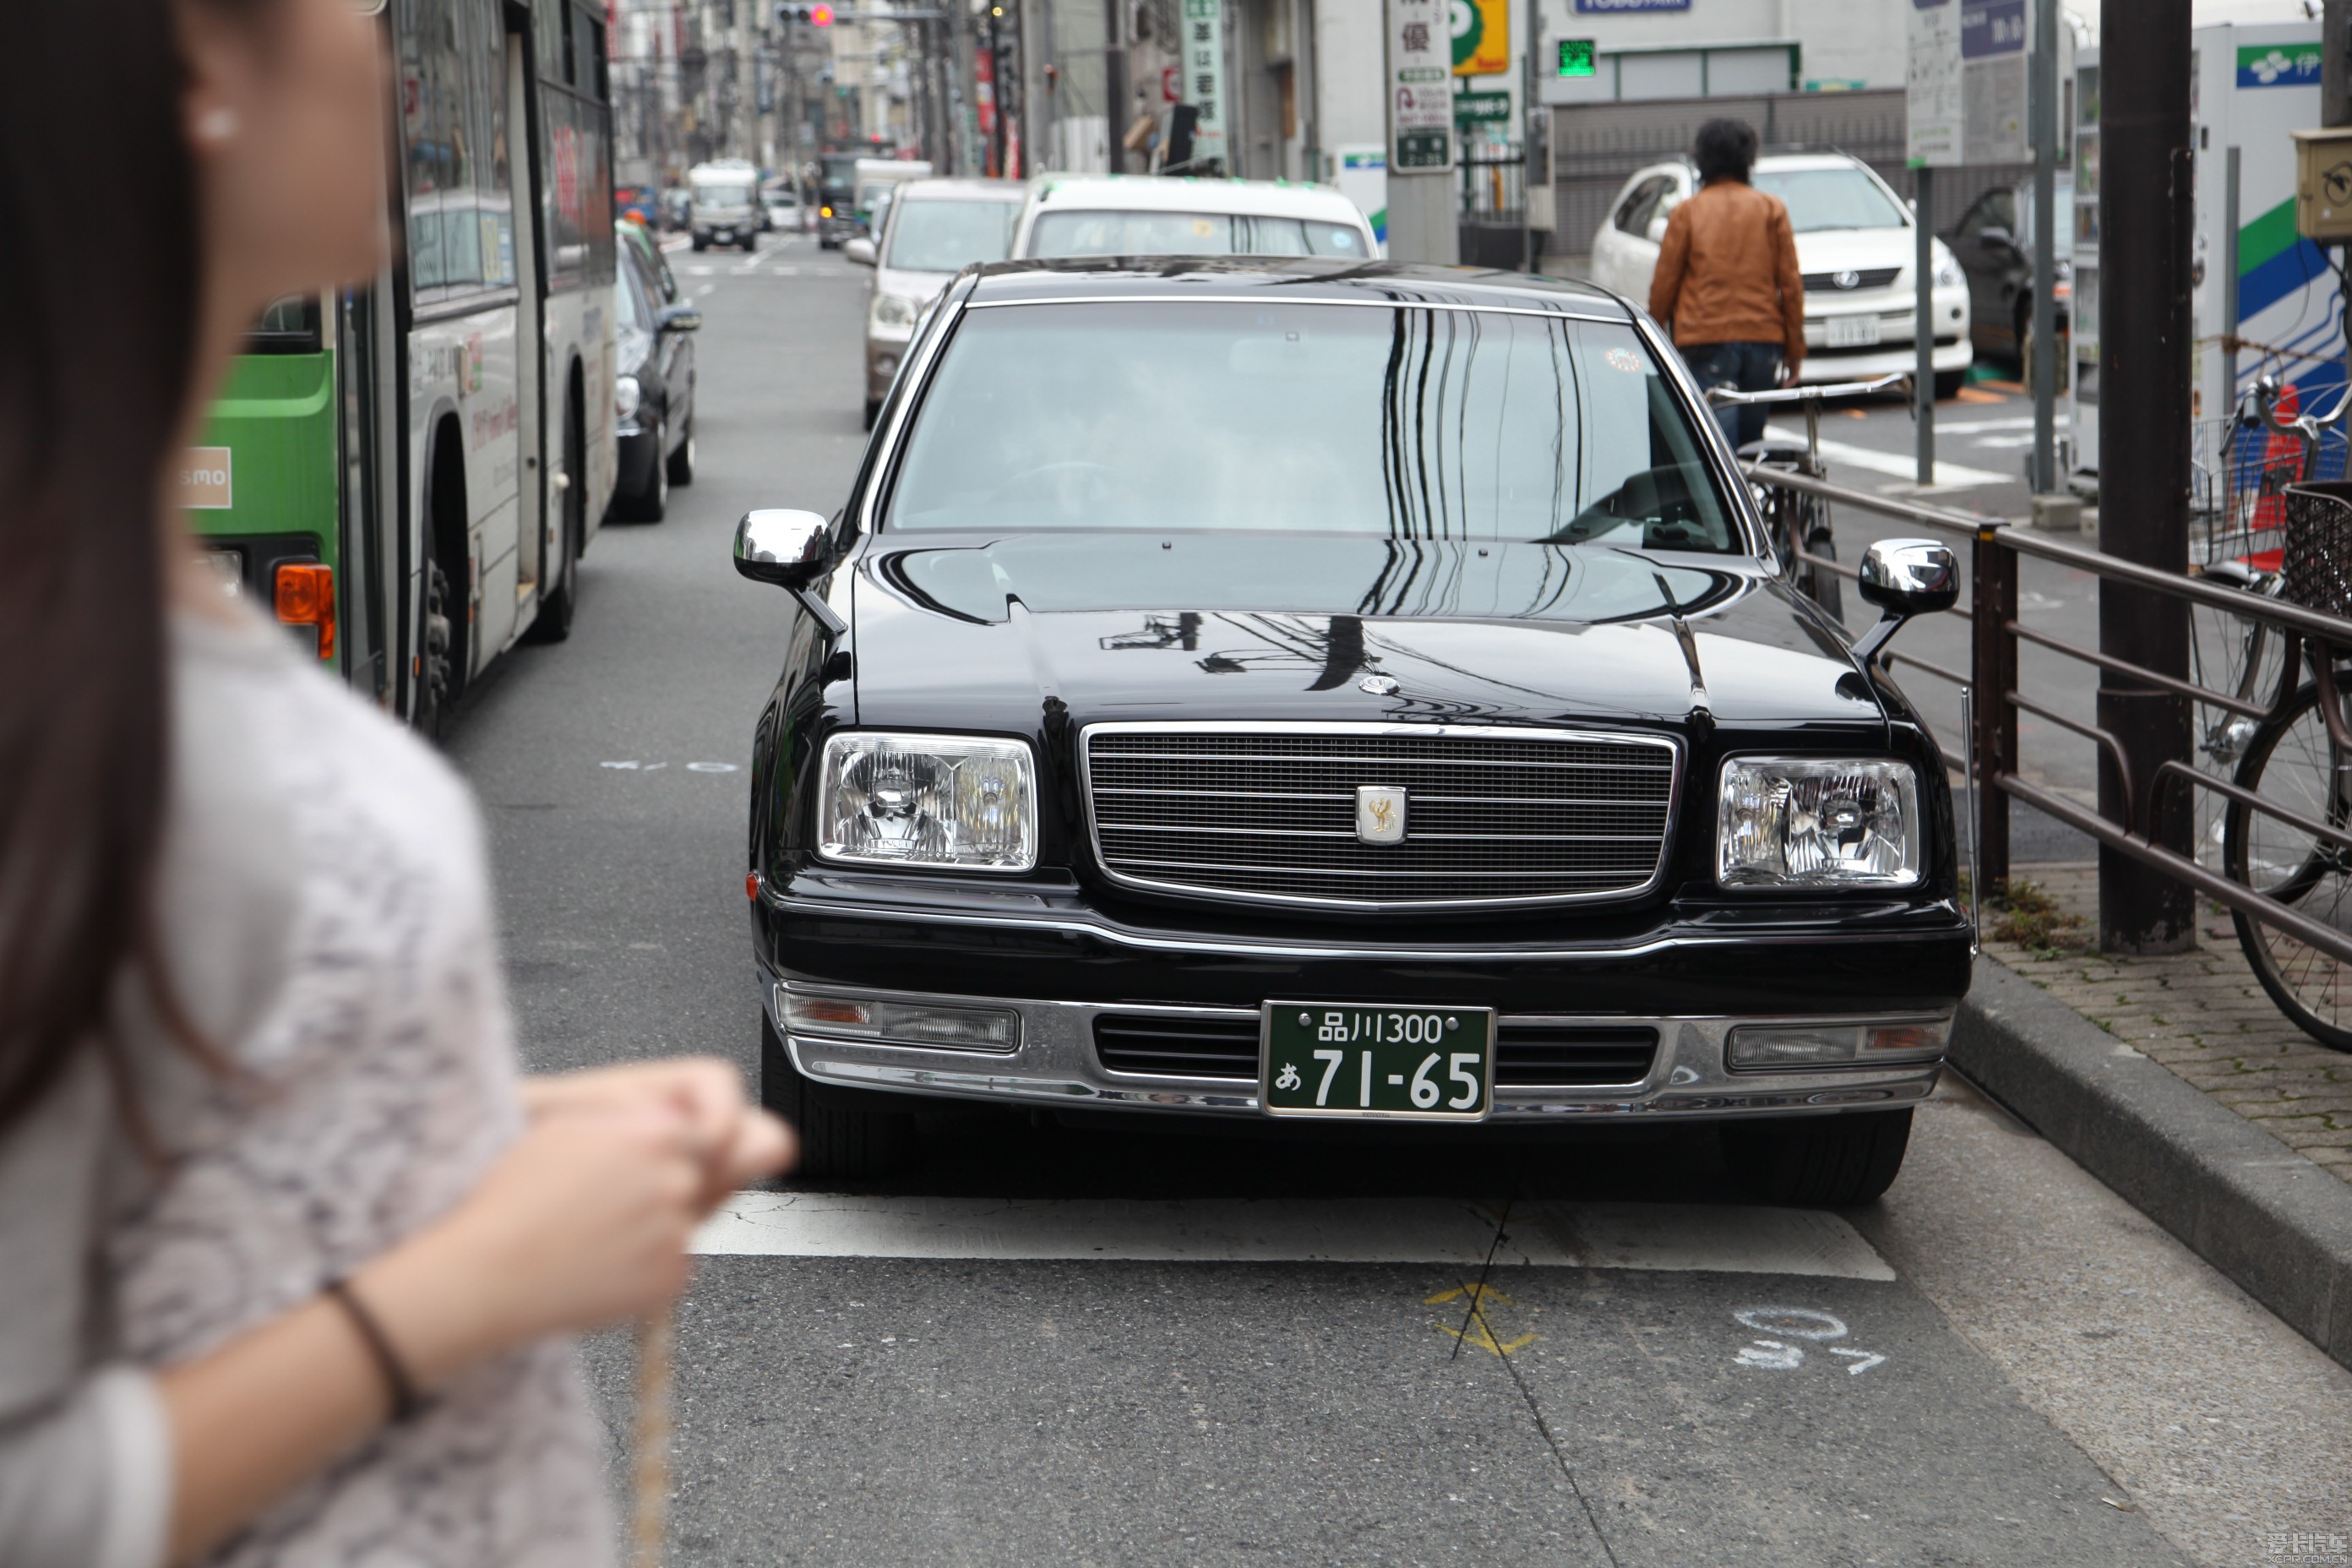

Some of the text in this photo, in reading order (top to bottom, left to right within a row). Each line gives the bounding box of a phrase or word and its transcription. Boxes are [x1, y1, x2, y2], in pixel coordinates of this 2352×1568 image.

[179, 469, 226, 486] smo
[1275, 1049, 1480, 1110] あ 71-65
